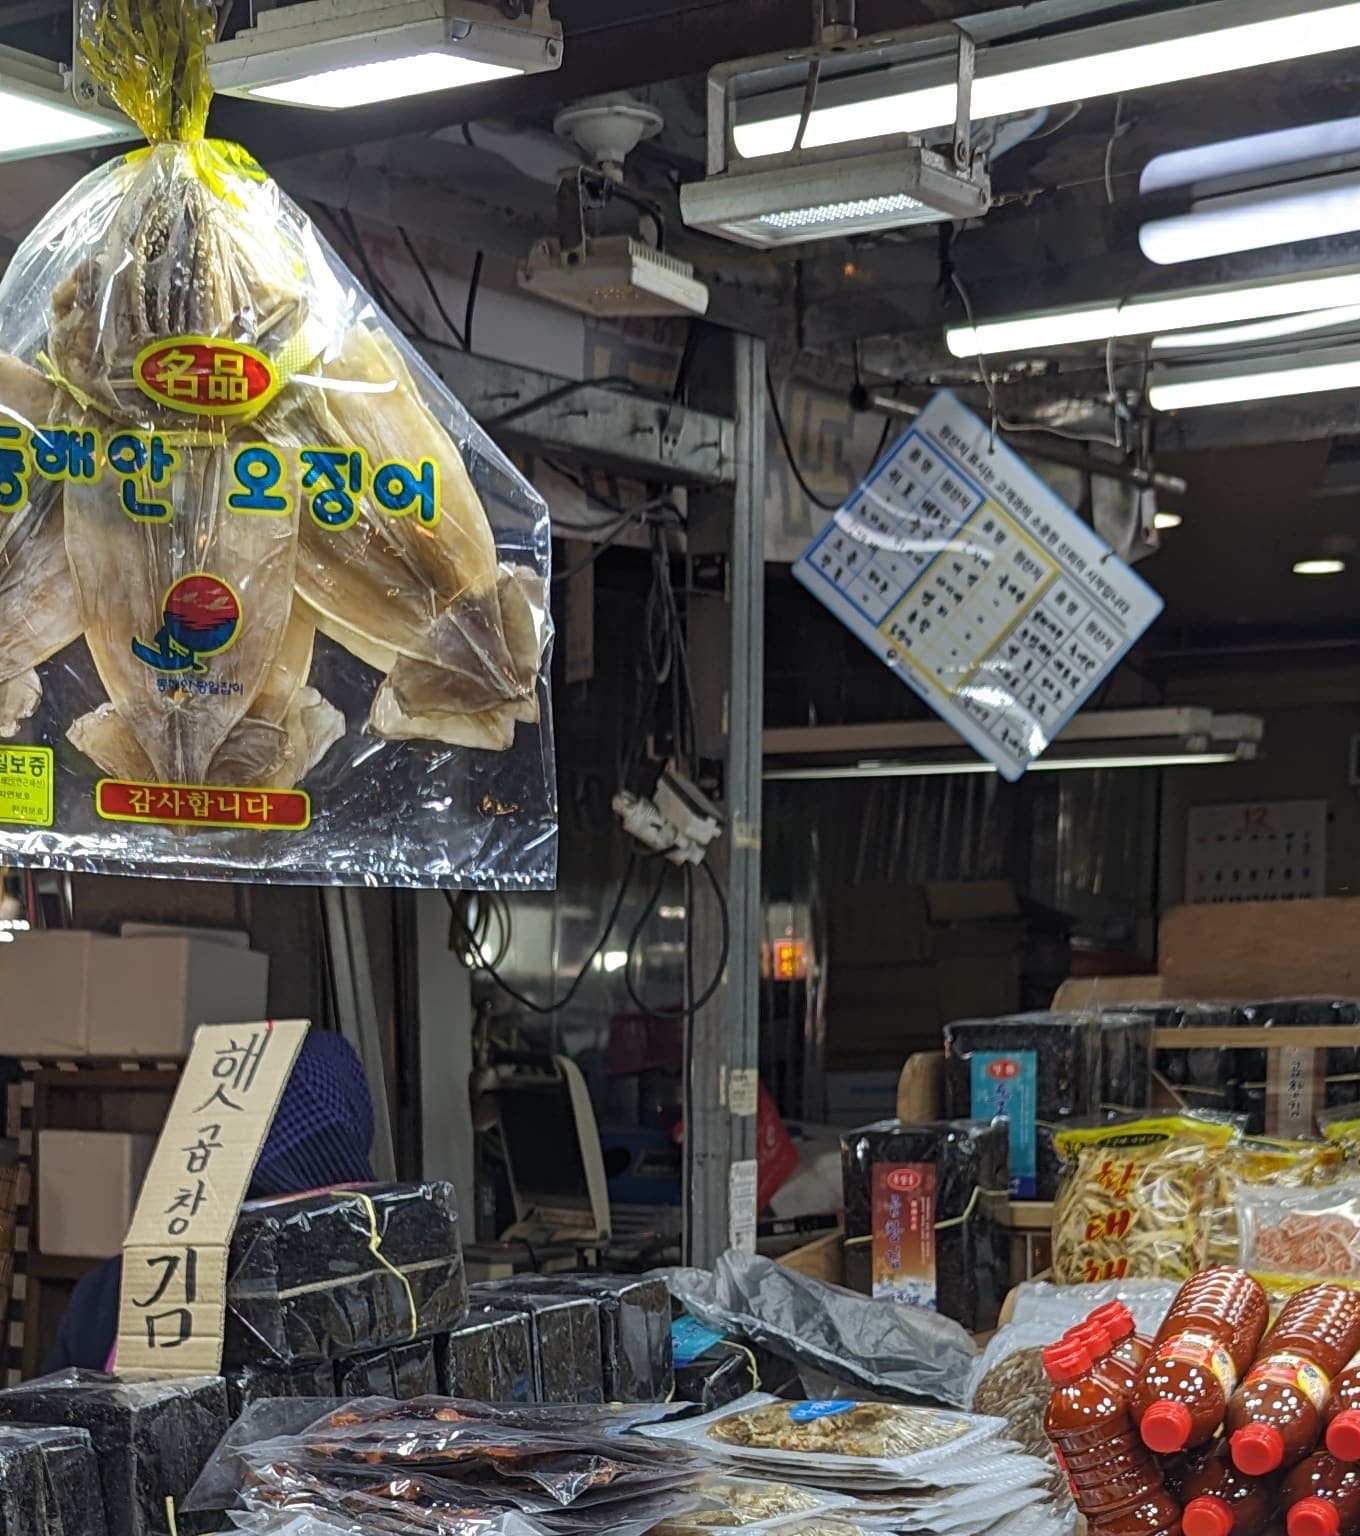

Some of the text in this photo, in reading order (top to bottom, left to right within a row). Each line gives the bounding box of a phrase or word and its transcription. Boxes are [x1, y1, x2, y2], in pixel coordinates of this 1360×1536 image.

[156, 350, 249, 401] 名品
[229, 443, 439, 527] 오징어
[129, 788, 273, 822] 감사합니다
